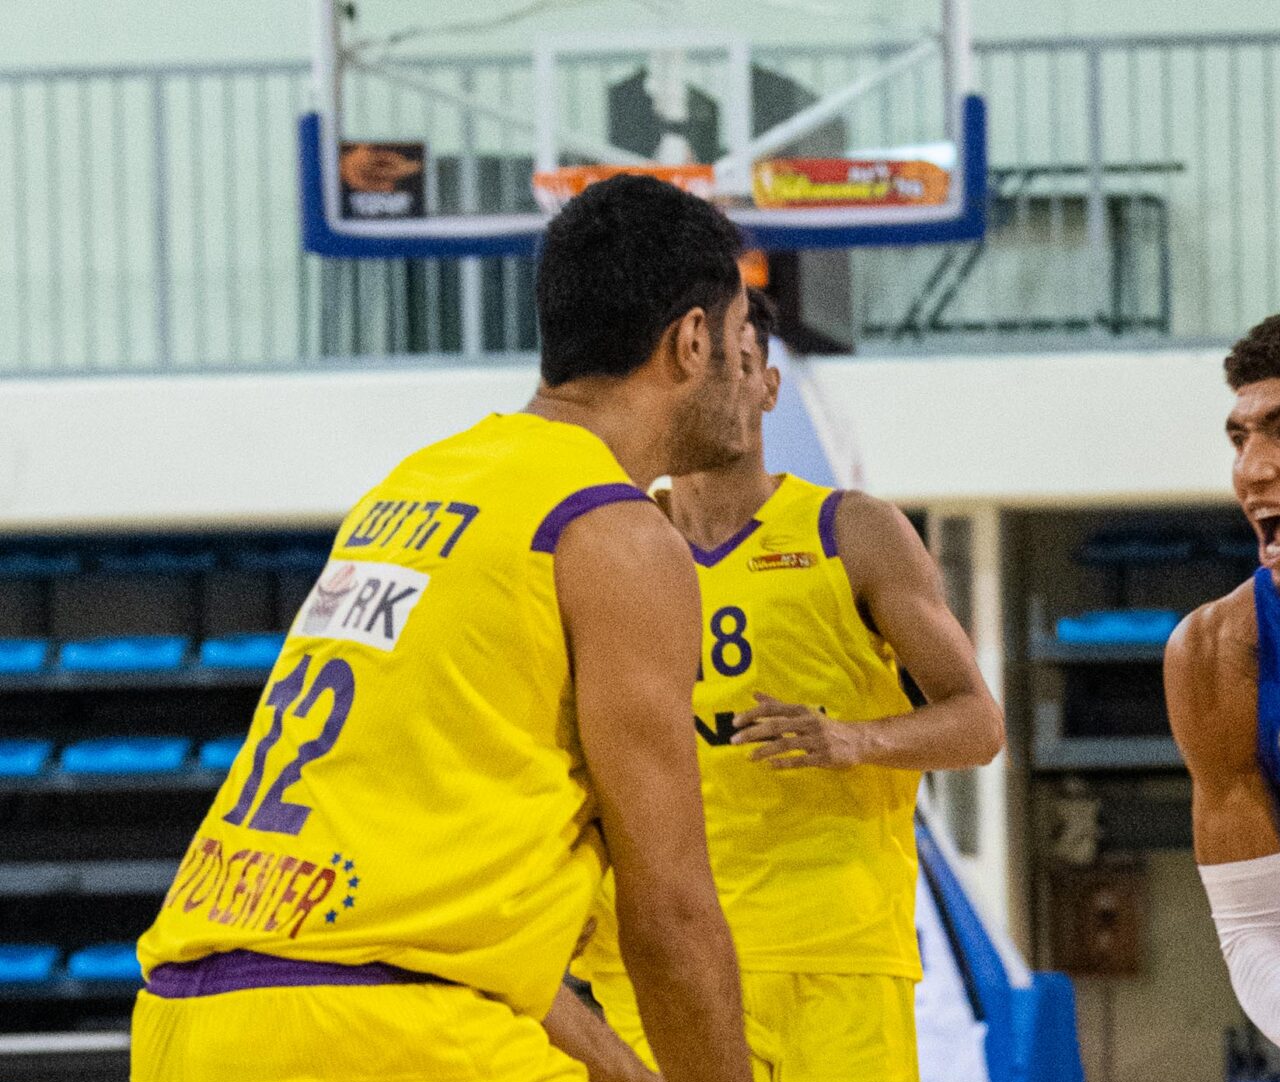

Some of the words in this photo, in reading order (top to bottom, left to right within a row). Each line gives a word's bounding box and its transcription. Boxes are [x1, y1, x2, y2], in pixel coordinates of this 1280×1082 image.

[344, 500, 480, 558] הרוש
[697, 605, 752, 680] 8
[222, 654, 355, 836] 12
